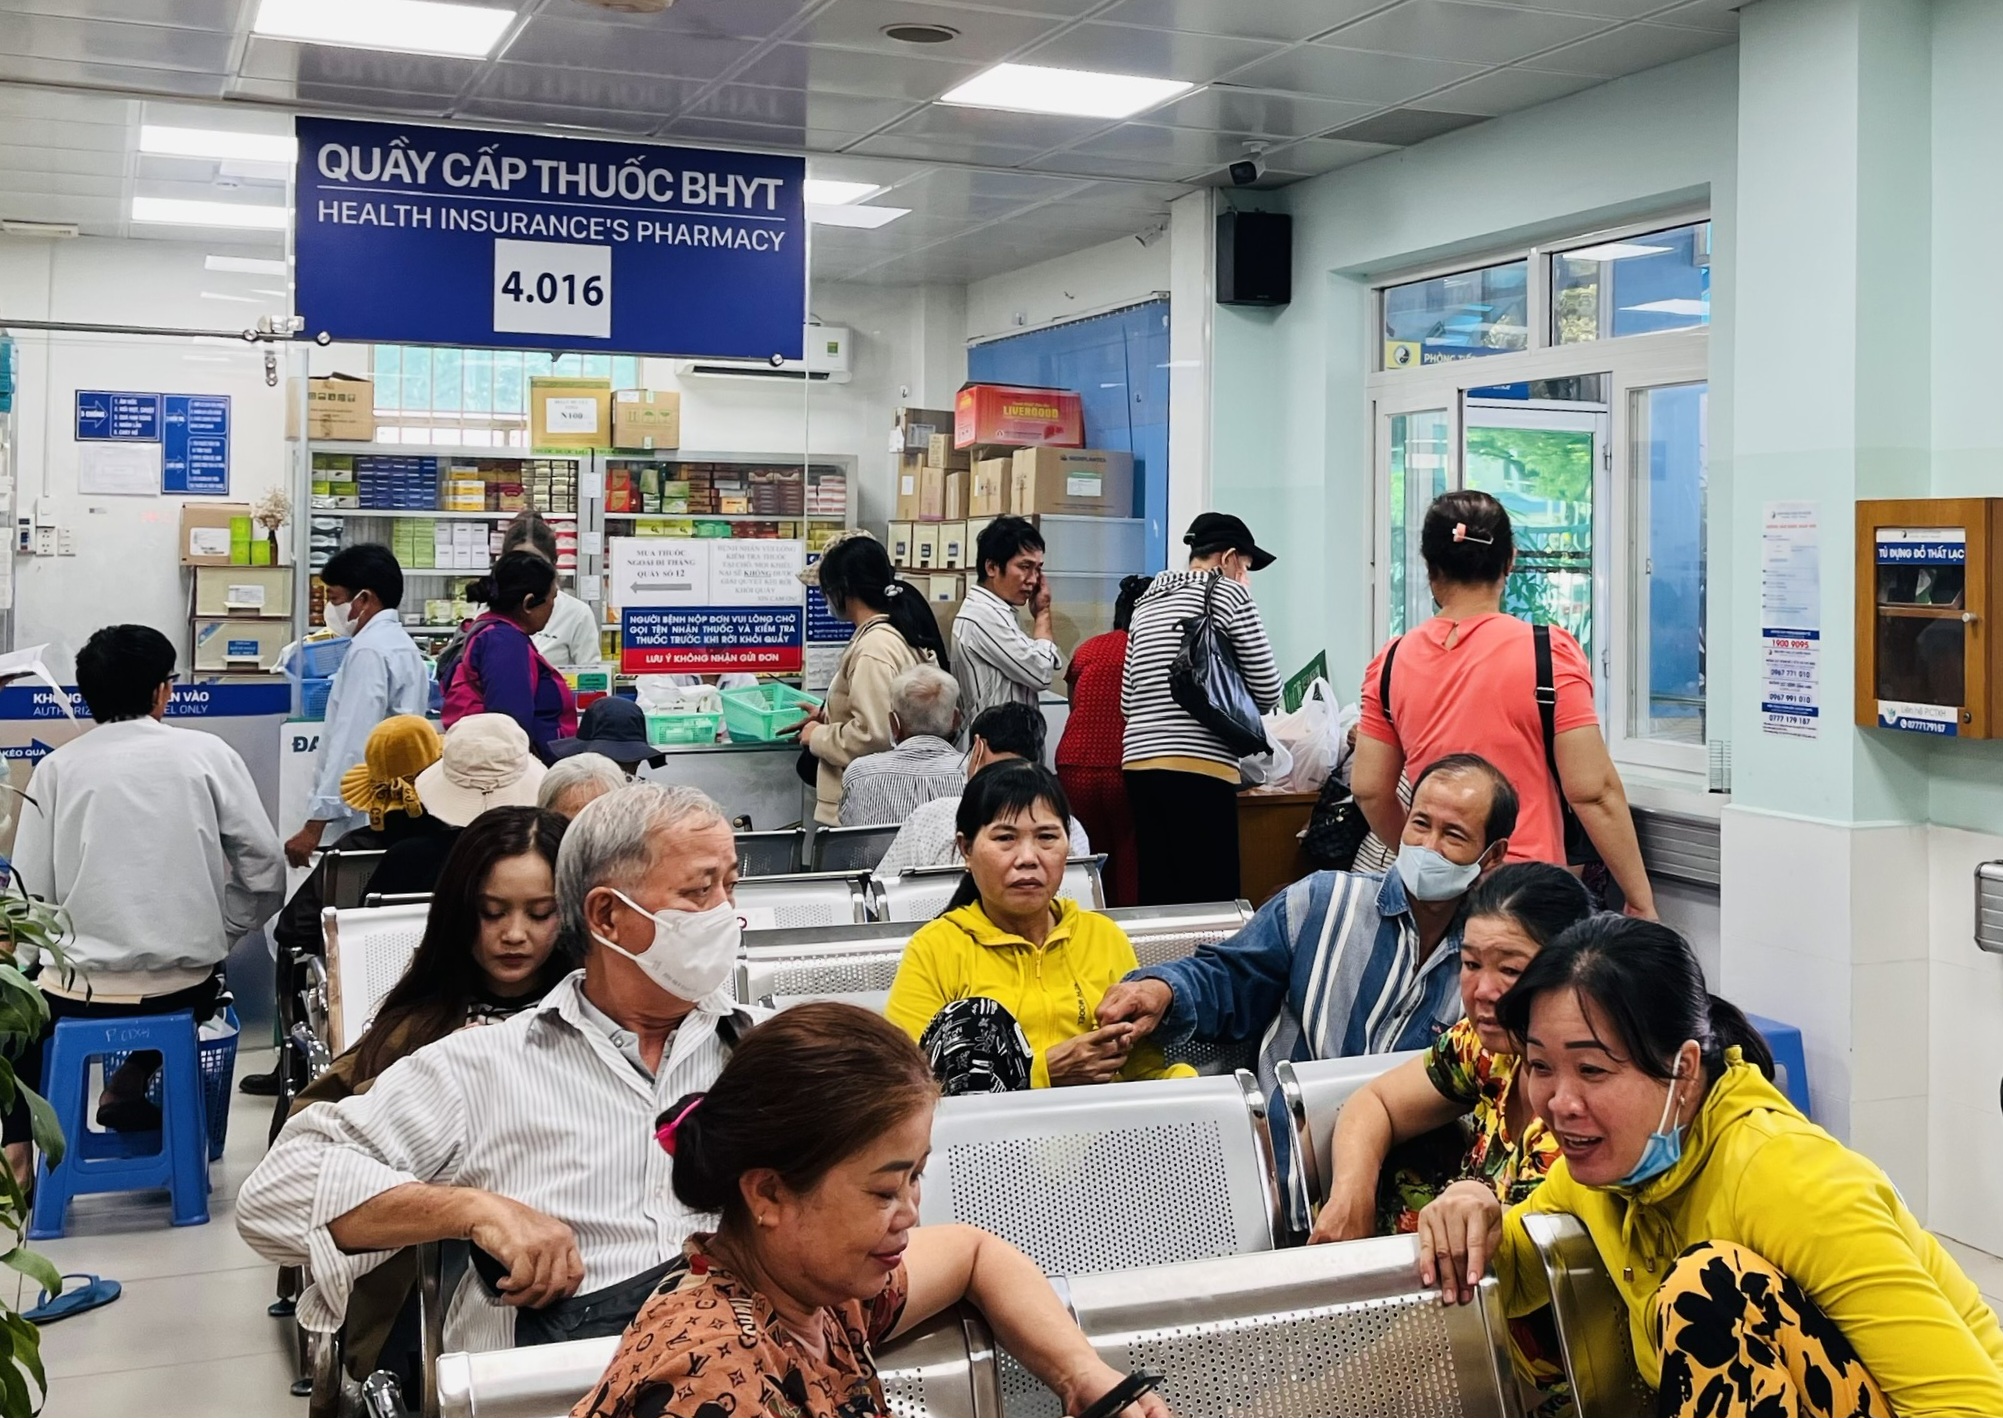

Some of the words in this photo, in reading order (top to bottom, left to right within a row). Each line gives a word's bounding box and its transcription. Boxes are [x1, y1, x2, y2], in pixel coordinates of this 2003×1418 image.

[317, 136, 437, 184] QUẦY
[442, 143, 527, 191] CẤP
[533, 155, 675, 203] THUỐC
[681, 171, 784, 211] BHYT
[318, 201, 433, 229] HEALTH
[441, 207, 630, 242] INSURANCE'S
[637, 221, 786, 252] PHARMACY
[501, 271, 605, 307] 4.016
[1948, 549, 1965, 562] LẠC
[675, 569, 685, 577] 12
[629, 614, 660, 624] NGƯỜI
[662, 614, 686, 625] BỆNH
[688, 614, 708, 625] NỘP
[709, 615, 730, 623] ĐƠN
[731, 615, 747, 623] VUI
[748, 613, 773, 623] LÒNG
[775, 613, 796, 623] CHỜ
[629, 625, 648, 635] GỌI
[702, 622, 734, 633] THUỐC
[738, 623, 751, 633] VÀ
[779, 625, 796, 633] TRA
[636, 632, 668, 644] THUỐC
[703, 635, 719, 643] KHI
[1772, 639, 1789, 648] 1900
[1791, 640, 1809, 649] 9095
[646, 653, 664, 663] LƯU
[665, 652, 672, 663] Ý
[673, 652, 709, 662] KHÔNG
[710, 652, 738, 664] NHẬN
[758, 653, 779, 662] ĐƠN
[1786, 669, 1797, 677] 771
[33, 693, 82, 704] KHG
[183, 689, 210, 702] VÀO
[1769, 693, 1785, 701] 0967
[1786, 694, 1797, 702] 991
[1798, 696, 1810, 704] 010
[179, 704, 209, 714] ONLY
[1769, 714, 1784, 723] 0777
[1786, 716, 1797, 724] 179
[25, 748, 47, 757] QUA
